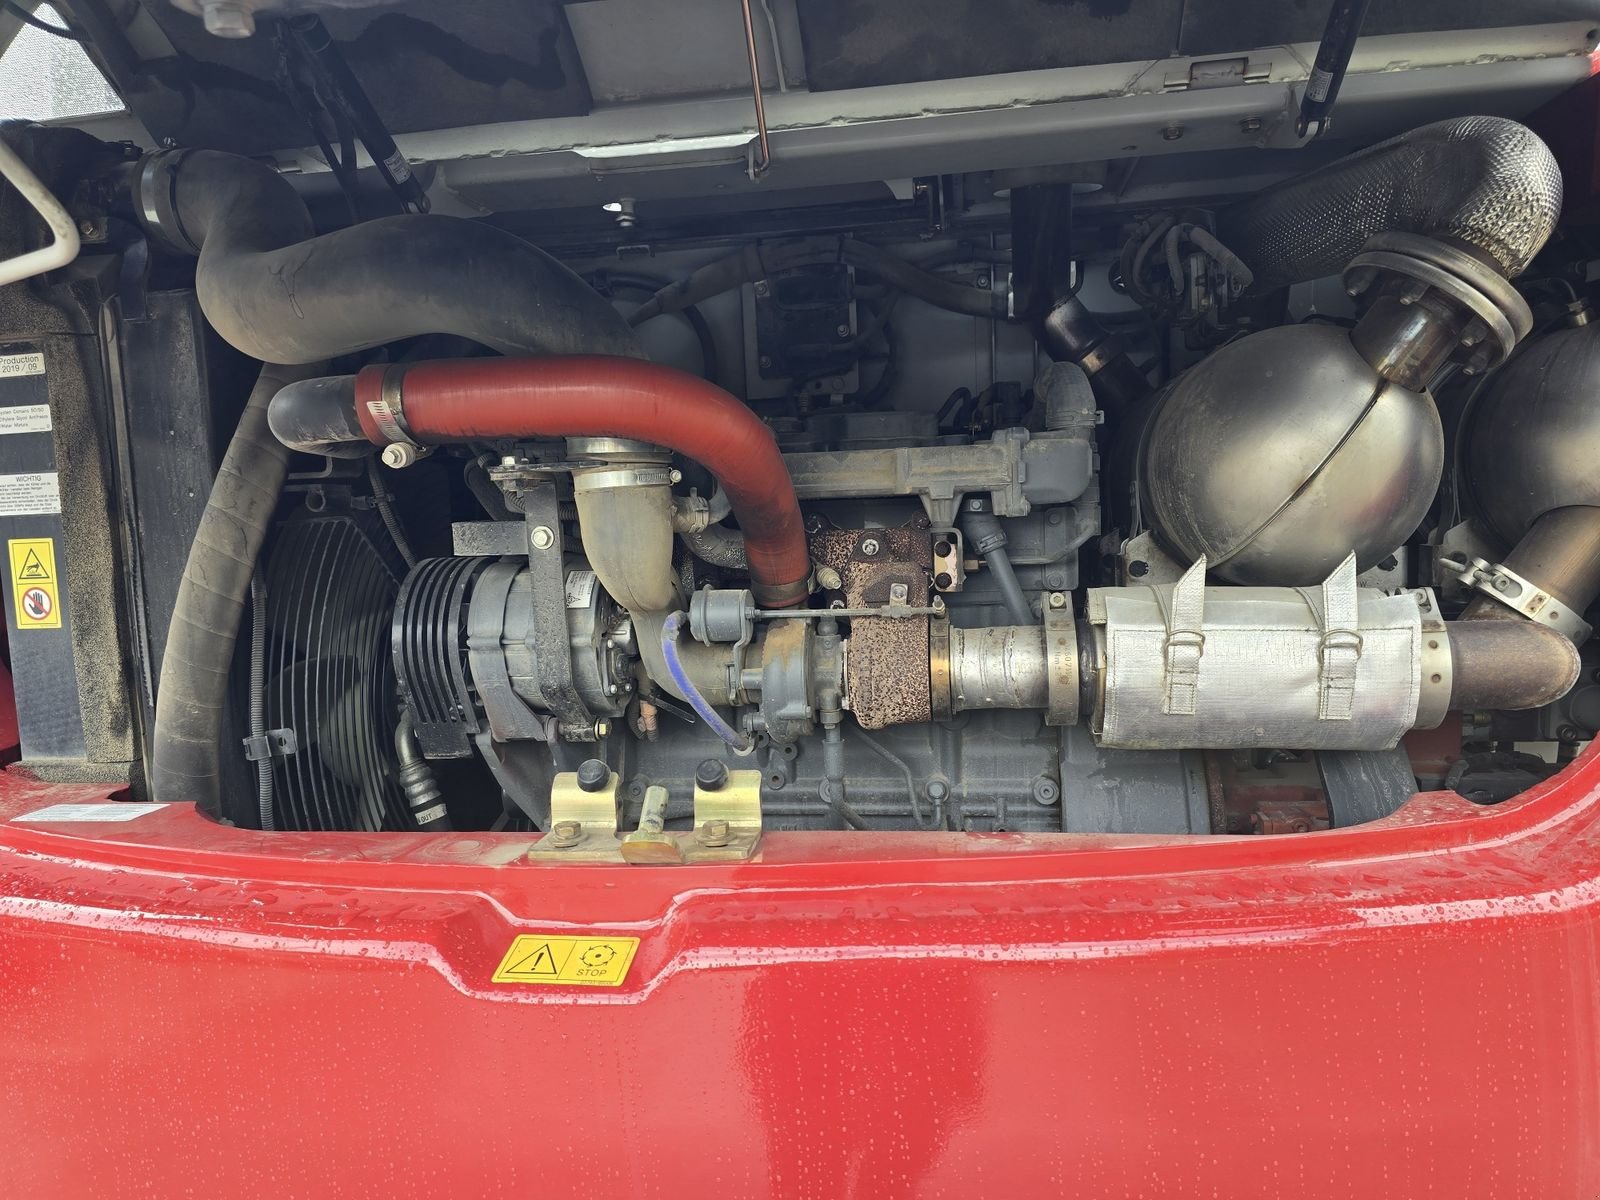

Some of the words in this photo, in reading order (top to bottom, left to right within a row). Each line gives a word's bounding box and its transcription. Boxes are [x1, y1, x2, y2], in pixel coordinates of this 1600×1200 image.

[0, 356, 39, 365] Production
[2, 364, 19, 373] 2019
[576, 968, 607, 977] STOP
